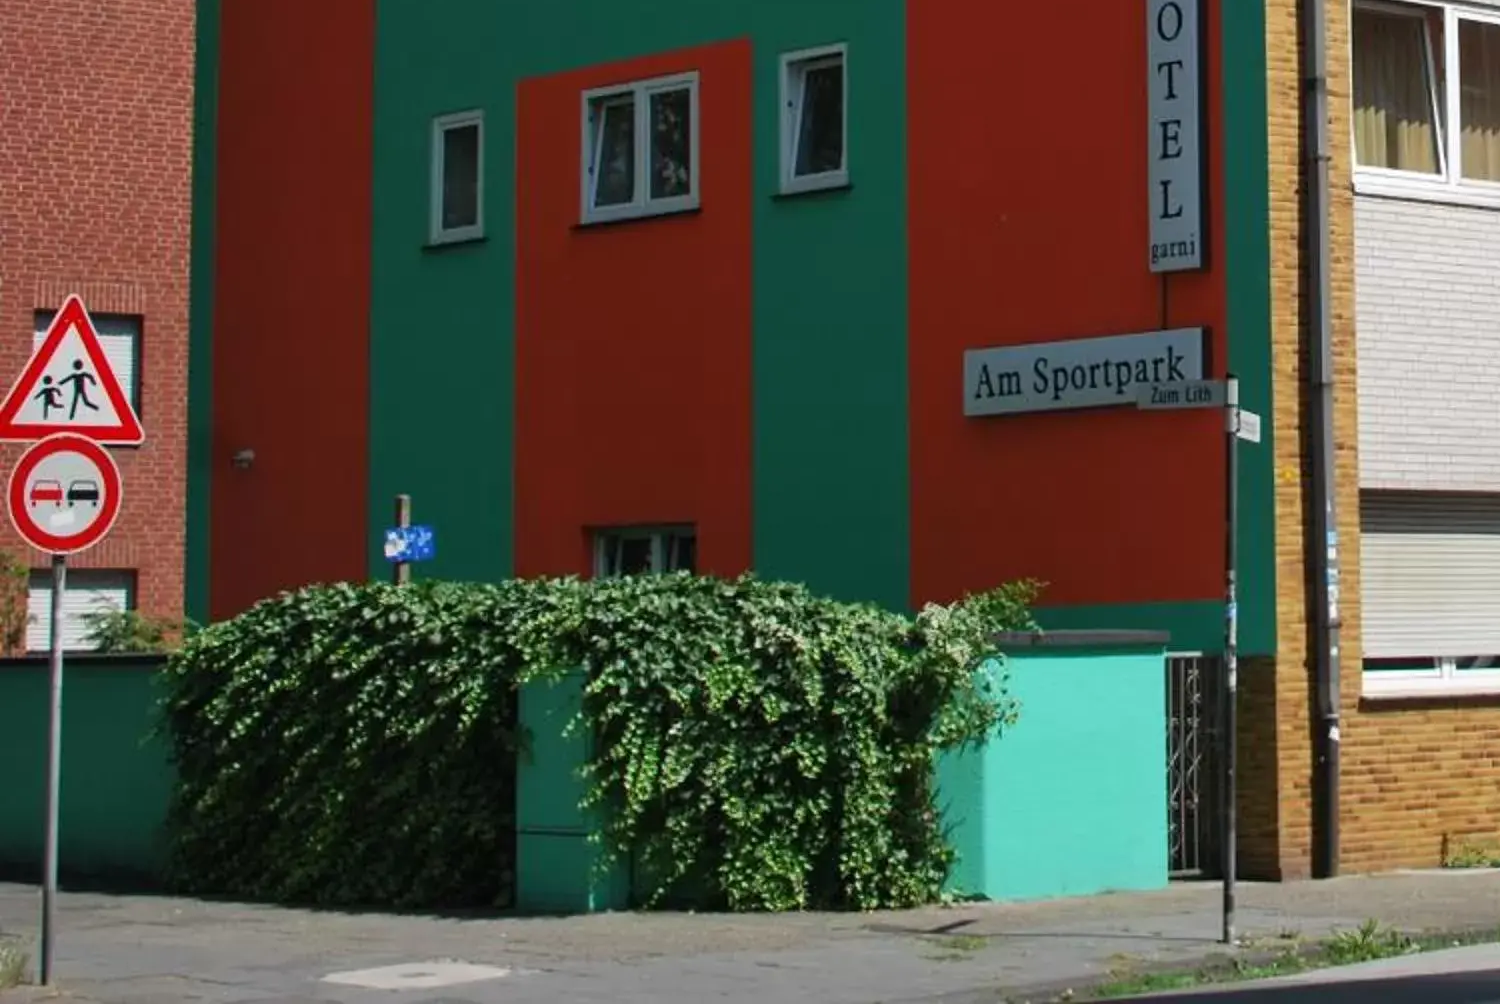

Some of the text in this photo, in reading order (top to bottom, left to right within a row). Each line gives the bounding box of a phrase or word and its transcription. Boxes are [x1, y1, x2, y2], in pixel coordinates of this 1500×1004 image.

[1151, 233, 1195, 264] garni
[974, 346, 1186, 400] Am Sportpark
[1151, 384, 1212, 405] Zum Lith
